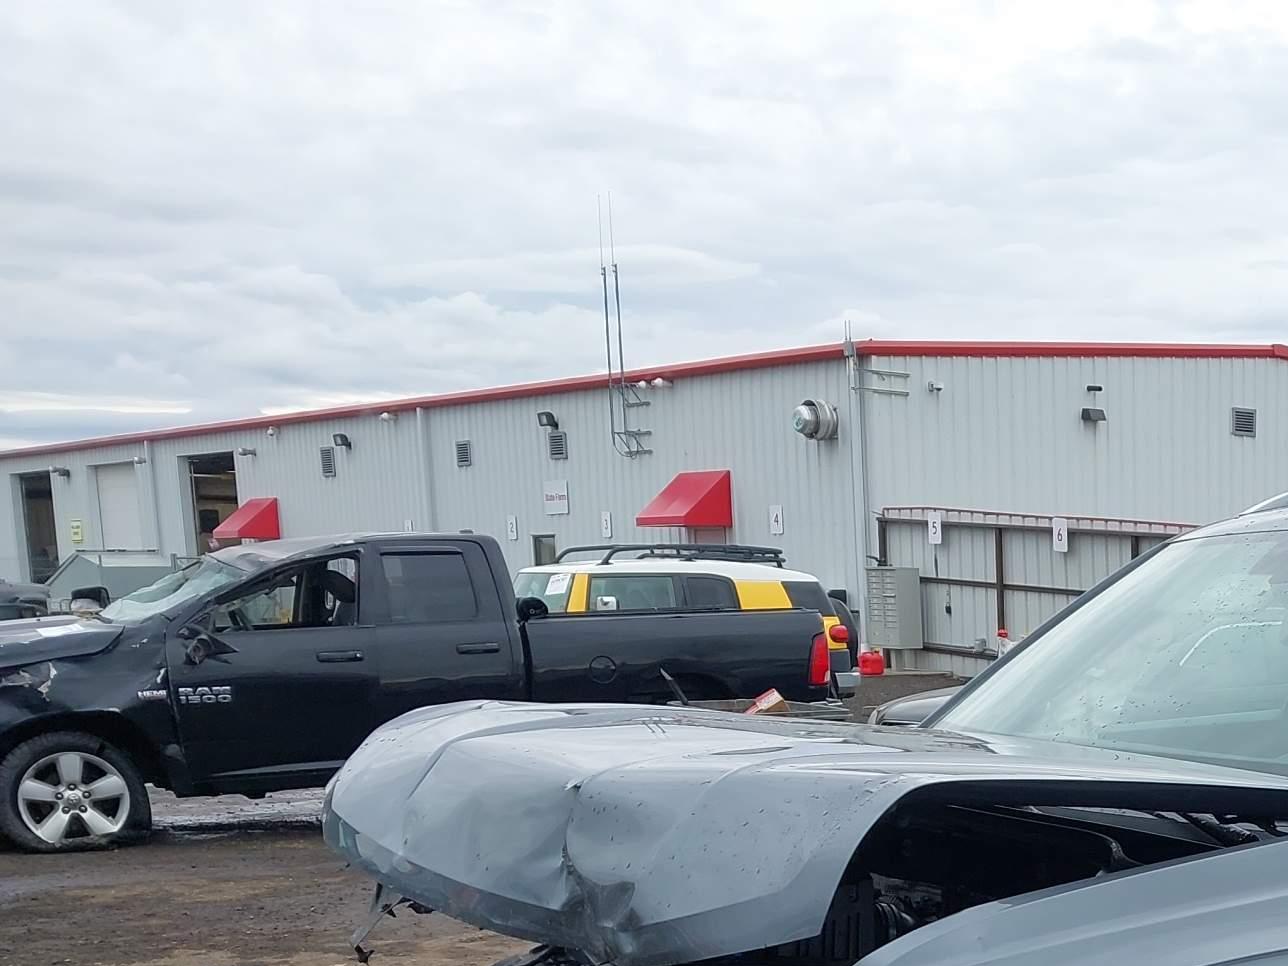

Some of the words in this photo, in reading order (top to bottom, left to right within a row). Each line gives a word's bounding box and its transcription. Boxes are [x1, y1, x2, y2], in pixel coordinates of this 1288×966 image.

[773, 512, 779, 527] 4
[509, 521, 515, 533] 2
[932, 521, 937, 535] 5
[1057, 528, 1063, 542] 6
[137, 689, 167, 699] HEMI
[178, 686, 232, 696] RAM
[179, 694, 232, 704] 1500
